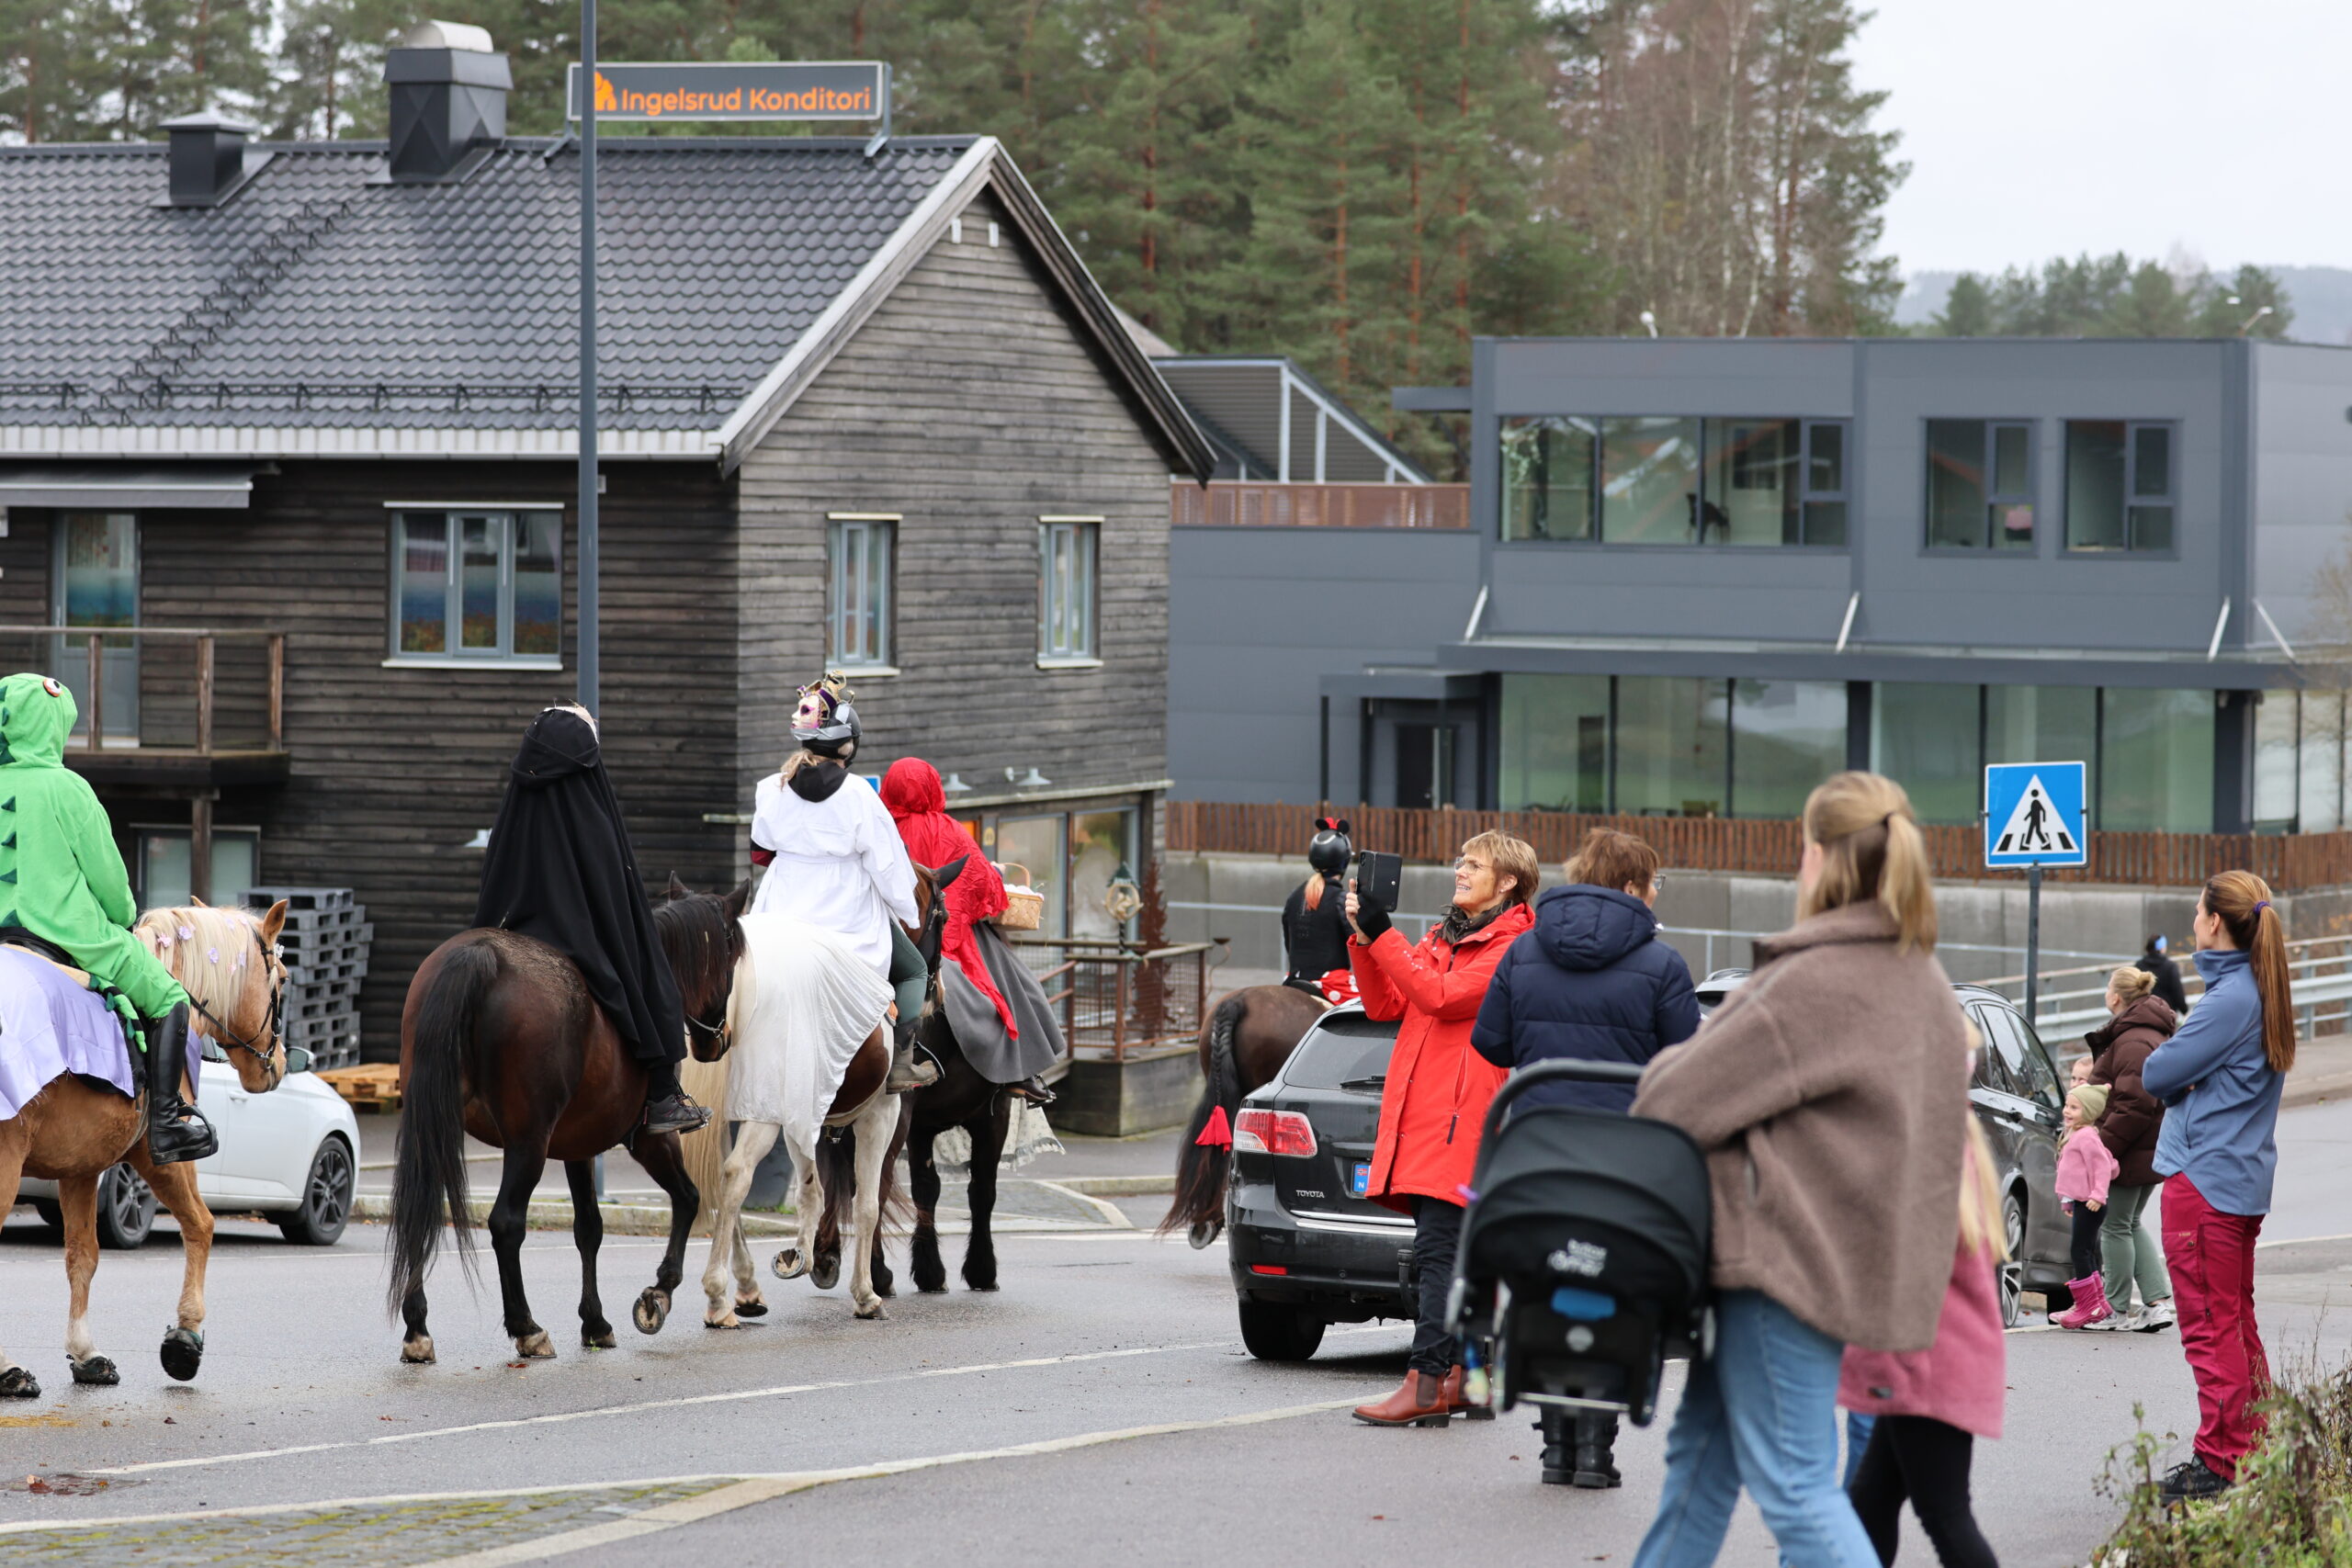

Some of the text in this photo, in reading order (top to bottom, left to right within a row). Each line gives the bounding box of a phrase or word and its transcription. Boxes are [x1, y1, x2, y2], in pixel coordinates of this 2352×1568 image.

[621, 86, 871, 116] Ingelsrud Konditori
[1295, 1190, 1325, 1199] TOYOTA
